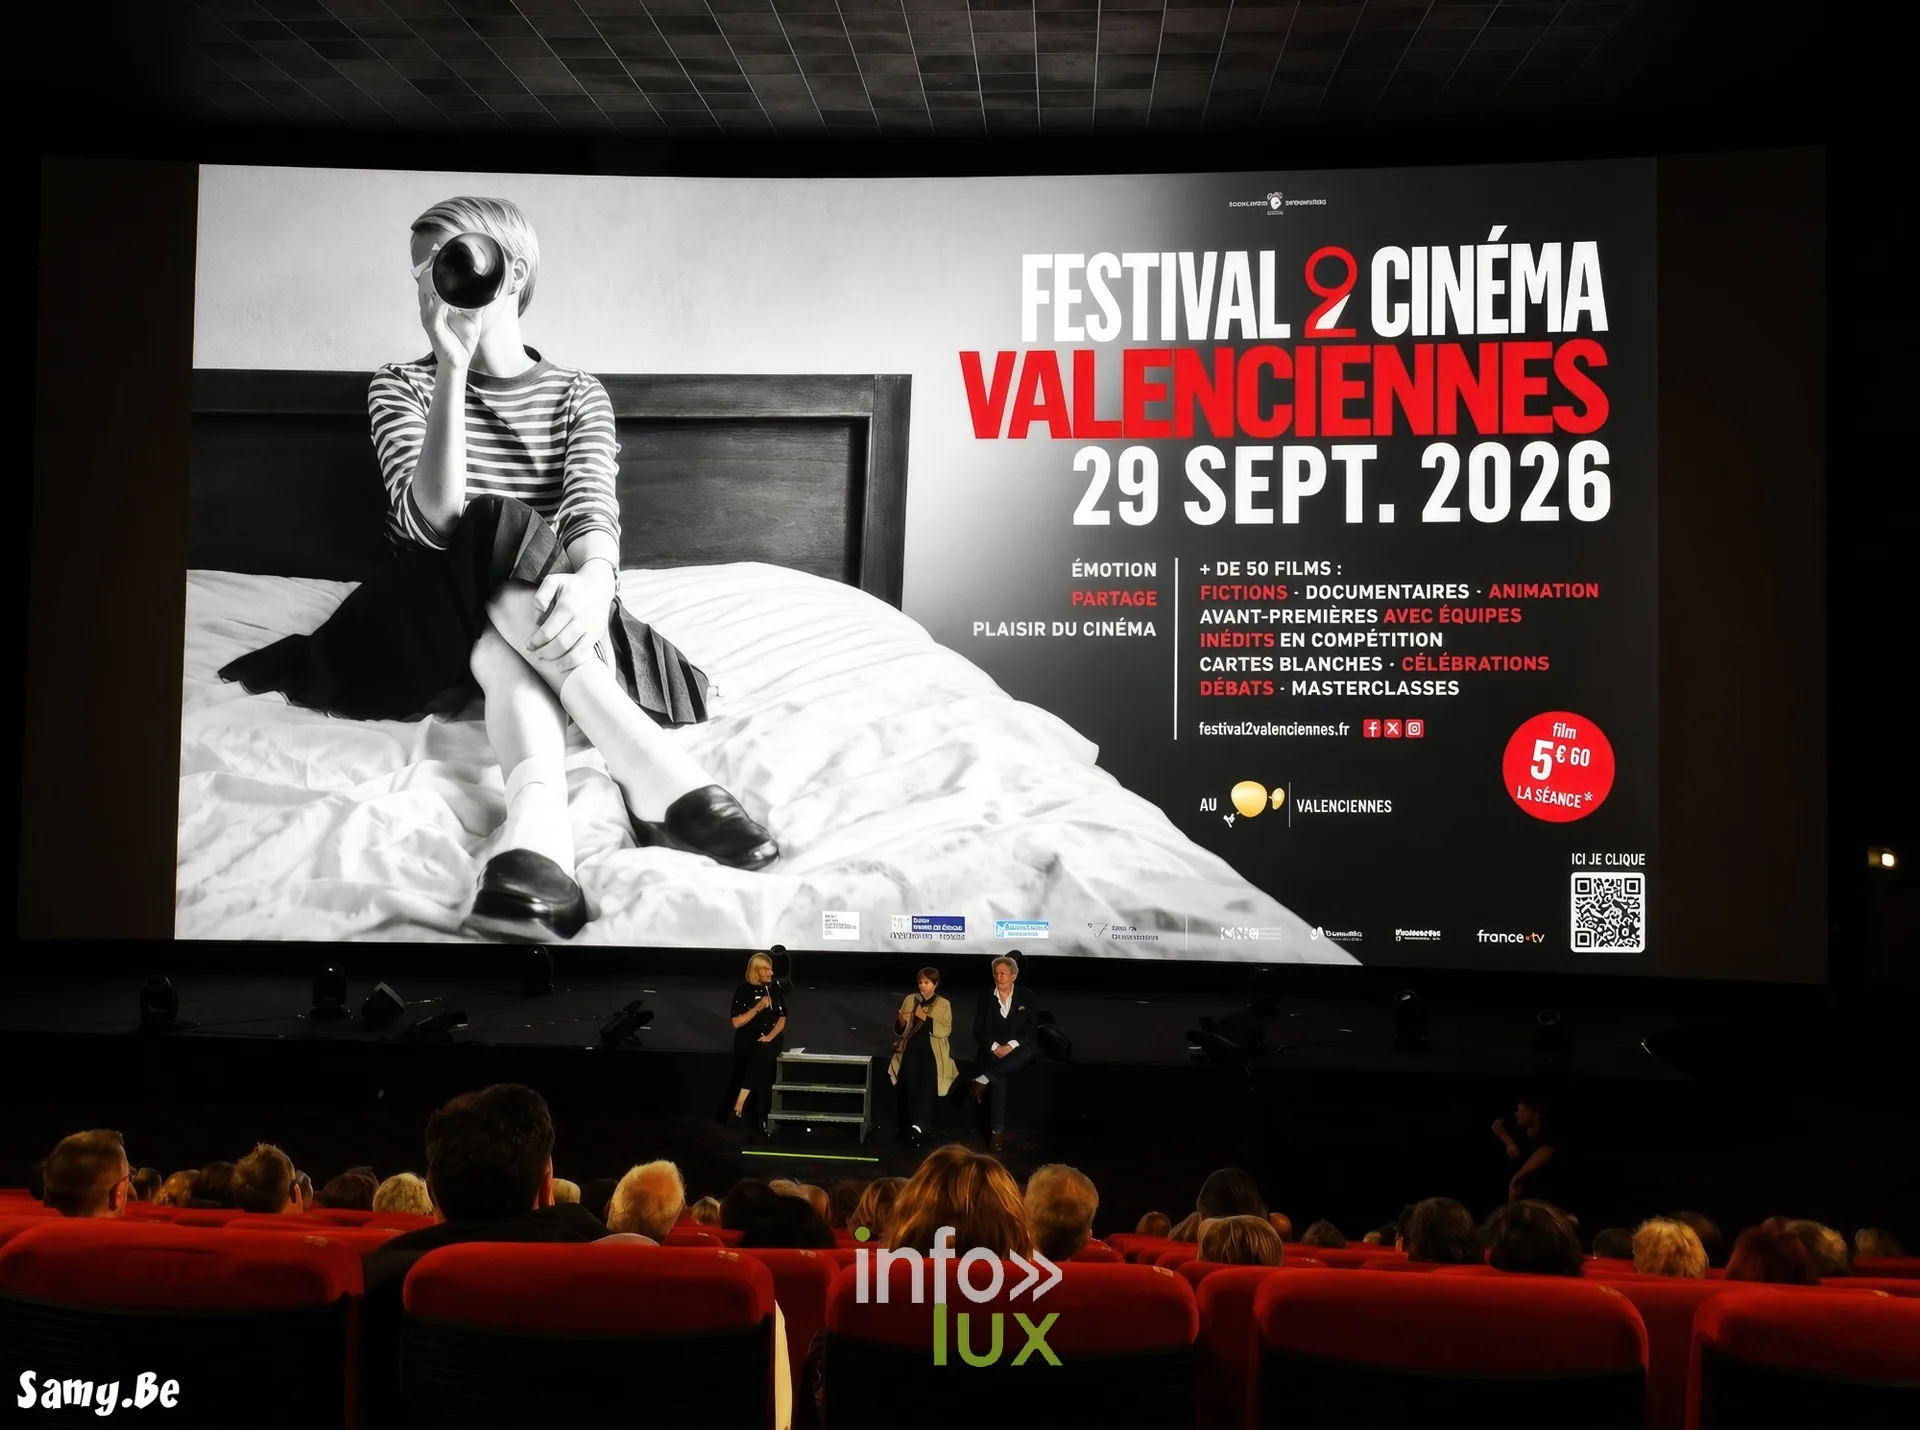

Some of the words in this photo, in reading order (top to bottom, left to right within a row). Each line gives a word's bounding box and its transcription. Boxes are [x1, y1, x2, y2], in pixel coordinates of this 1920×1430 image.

[1021, 249, 1291, 343] FESTIVAL
[1303, 246, 1359, 339] 2
[1371, 224, 1609, 338] CINÉMA
[959, 338, 1610, 440] VALENCIENNES
[1072, 445, 1159, 527] 29
[1183, 444, 1395, 526] SEPT.
[1421, 440, 1611, 524] 2026
[1071, 557, 1157, 578] ÉMOTION
[1216, 561, 1241, 577] DE
[1246, 560, 1269, 577] 50
[1274, 560, 1332, 577] FILMS
[1071, 590, 1157, 607] PARTAGE
[1200, 584, 1288, 601] FICTIONS
[1305, 583, 1470, 600] DOCUMENTAIRES
[1488, 582, 1600, 599] ANIMATION
[1199, 604, 1379, 625] AVANT-PREMIÈRES
[1383, 607, 1433, 624] AVEC
[1438, 603, 1523, 626] ÉQUIPES
[973, 621, 1046, 637] PLAISIR
[1051, 621, 1077, 637] DU
[1082, 616, 1157, 637] CINÉMA
[1200, 628, 1275, 648] INÉDITS
[1280, 632, 1305, 648] EN
[1311, 628, 1444, 648] COMPÉTITION
[1199, 656, 1274, 672] CARTES
[1279, 656, 1383, 672] BLANCHES
[1401, 651, 1550, 672] CÉLÉBRATIONS
[1200, 676, 1275, 696] DÉBATS
[1291, 680, 1460, 696] MASTERCLASSES
[1198, 721, 1350, 738] festival2valenciennes.fr
[1552, 721, 1577, 740] film
[1517, 785, 1532, 801] LA
[1199, 797, 1218, 812] AU
[1296, 798, 1393, 814] VALENCIENNES
[1571, 852, 1586, 867] ICI
[1588, 852, 1603, 867] JE
[1605, 852, 1646, 867] CLIQUE
